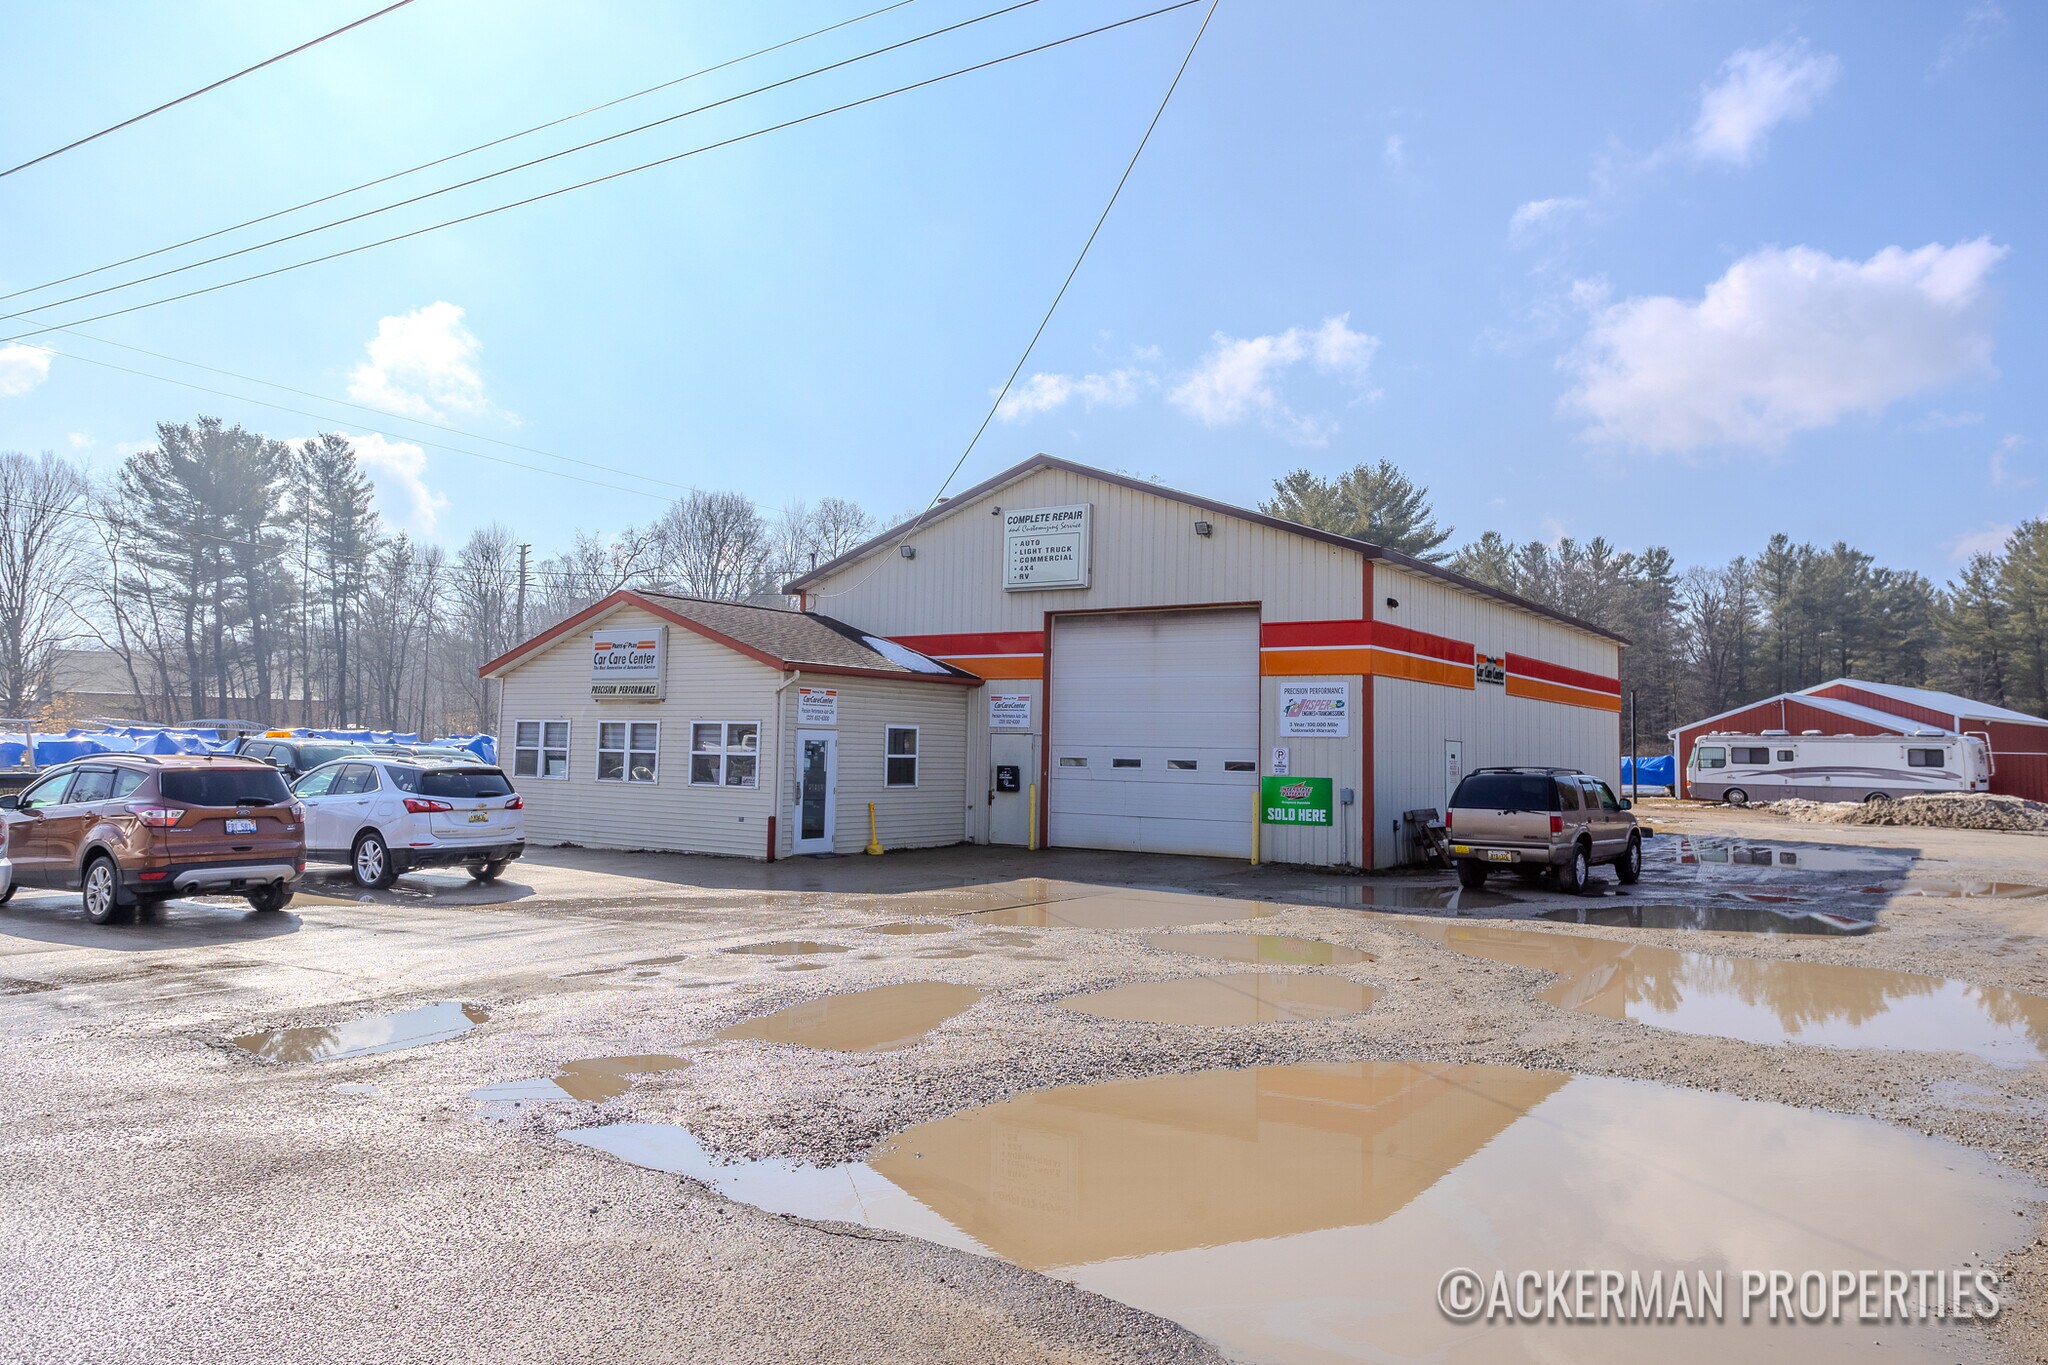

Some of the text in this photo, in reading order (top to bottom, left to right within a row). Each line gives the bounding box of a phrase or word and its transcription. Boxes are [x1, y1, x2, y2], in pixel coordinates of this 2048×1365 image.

[1008, 511, 1082, 524] COMPLETE REPAIR
[1022, 524, 1058, 533] Customizing
[1060, 522, 1080, 530] Service
[1020, 554, 1073, 563] COMMERCIAL
[594, 651, 655, 665] Car Care Center
[591, 685, 656, 694] PRECISION PERFORMANCE
[1288, 699, 1332, 717] JASPER
[1268, 808, 1326, 822] SOLD HERE
